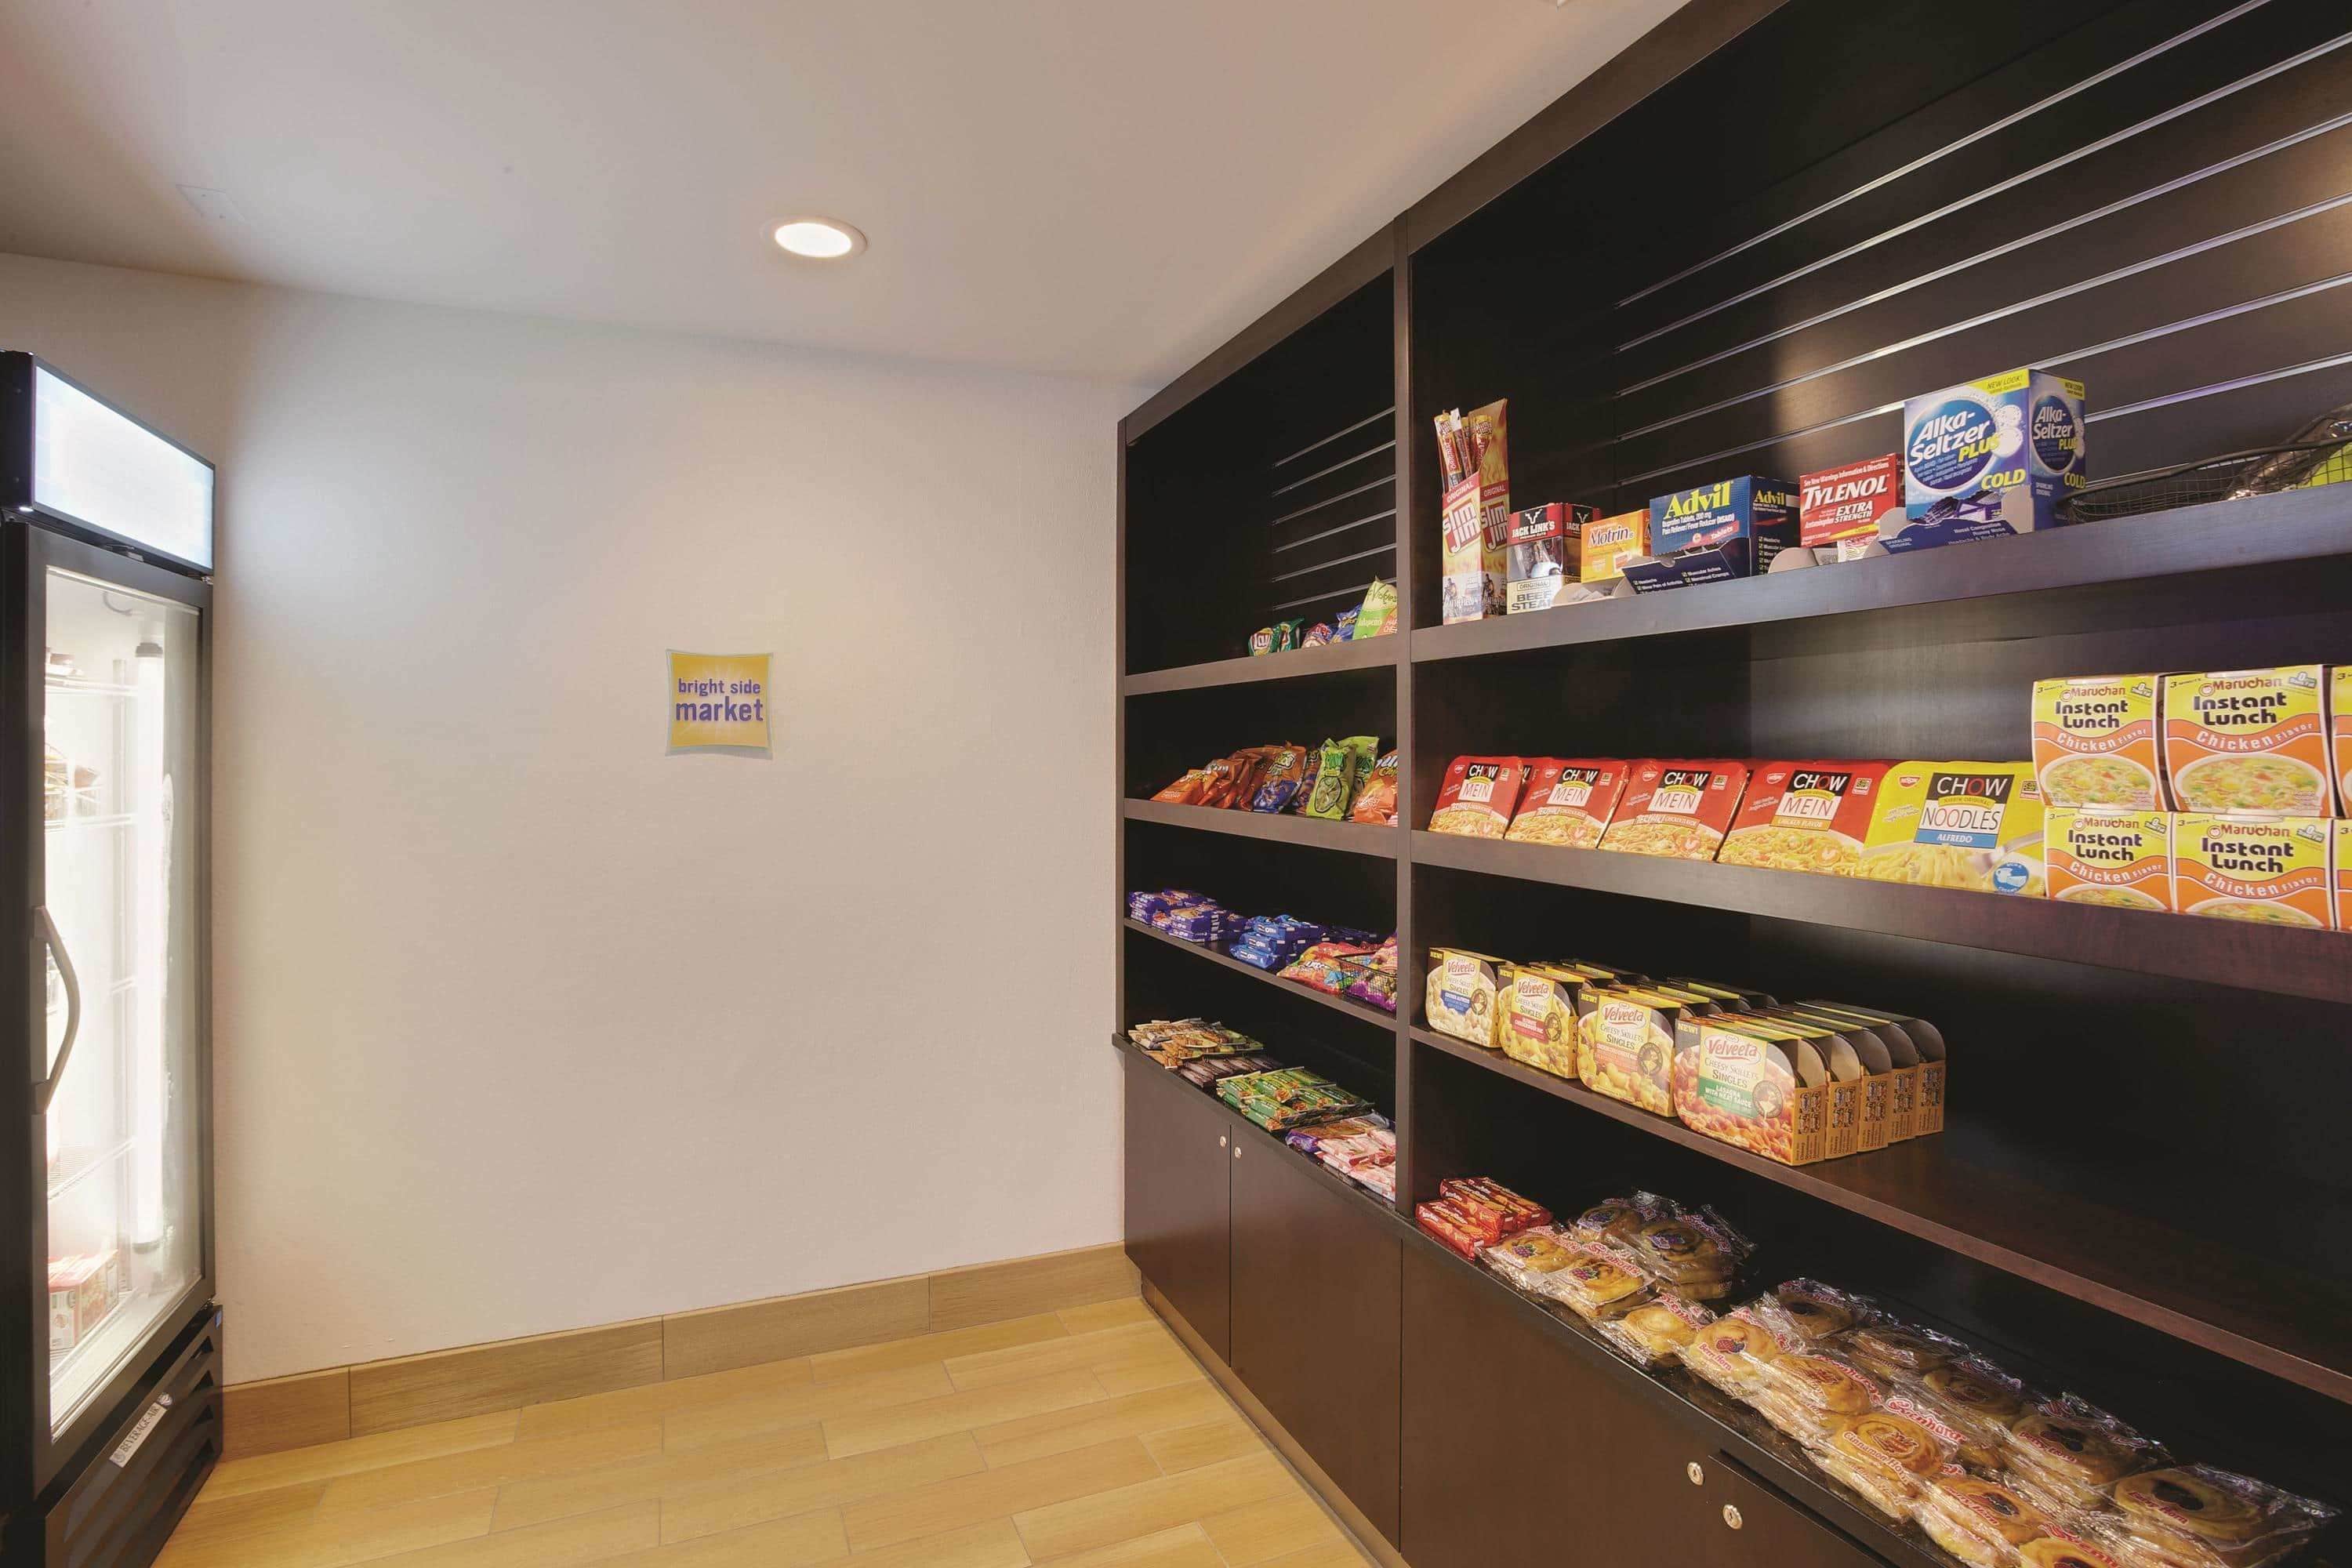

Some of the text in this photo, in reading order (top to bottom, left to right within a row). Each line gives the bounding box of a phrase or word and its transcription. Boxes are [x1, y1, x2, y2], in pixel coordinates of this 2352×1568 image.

[2035, 406, 2066, 423] Alka-
[1912, 411, 1976, 446] Alka-
[2033, 423, 2073, 440] Seltzer
[1908, 420, 1990, 466] Seltzer
[1958, 433, 1999, 463] PLUS
[1839, 468, 1863, 479] Information
[1867, 462, 1889, 472] Directions
[1981, 469, 2026, 490] COLD
[2063, 471, 2085, 489] COLD
[1446, 481, 1473, 503] ORIGINAL
[1483, 485, 1505, 498] ORIGINAL
[1663, 481, 1731, 519] Advil
[1755, 489, 1785, 506] Advil
[1802, 474, 1888, 511] TYLENOL
[1835, 510, 1872, 524] STRENGTH
[1836, 500, 1873, 517] EXTRA
[1512, 521, 1555, 539] JACK LINK'S
[1588, 525, 1629, 548] Motrin
[1711, 526, 1734, 540] Tablets
[1518, 581, 1549, 590] ORIGINAL
[1516, 590, 1552, 602] BEEF
[678, 678, 760, 696] bright side
[2071, 686, 2126, 697] Maruchan
[2212, 678, 2283, 691] Maruchan
[676, 696, 764, 721] market
[2056, 700, 2129, 715] Instant
[2194, 693, 2288, 710] Instant
[2063, 715, 2120, 728] Lunch
[2204, 710, 2278, 726] Lunch
[2057, 729, 2147, 751] Chicken Flavor
[2196, 723, 2314, 750] Chicken Flavor
[1468, 764, 1499, 778] CHOW
[1563, 769, 1598, 782] CHOW
[1664, 771, 1708, 786] CHOW
[1463, 783, 1491, 798] MEIN
[1794, 773, 1848, 791] CHOW
[1936, 776, 2007, 797] CHOW
[1555, 787, 1587, 802] MEIN
[1655, 793, 1697, 810] MEIN
[1783, 797, 1834, 816] MEIN
[1922, 807, 2001, 830] NOODLES
[2084, 818, 2140, 829] Maruchan
[1936, 833, 1973, 844] ALFREDO
[2068, 830, 2142, 847] Instant
[2221, 824, 2289, 837] Maruchan
[2076, 845, 2134, 861] Lunch
[2201, 838, 2294, 857] Instant
[2070, 862, 2162, 883] Chicken Flavor
[2212, 855, 2283, 873] Lunch
[2204, 873, 2318, 895] Chicken Flavor
[1446, 960, 1475, 974] Velveeta
[1450, 984, 1469, 995] SINGLES
[1518, 982, 1550, 994] Velveeta
[1581, 993, 1597, 1003] NEW!
[1519, 1006, 1542, 1018] SINGLES
[1604, 1007, 1645, 1022] Velveeta
[1600, 1023, 1620, 1036] CHEESY
[1678, 1023, 1698, 1035] NEW!
[1606, 1034, 1635, 1050] SINGLES
[1708, 1039, 1759, 1058] Velveeta
[1704, 1058, 1730, 1071] CHEESY
[1712, 1069, 1748, 1088] SINGLES
[1715, 1354, 1734, 1372] Horn
[1843, 1432, 1887, 1461] Cinnamon
